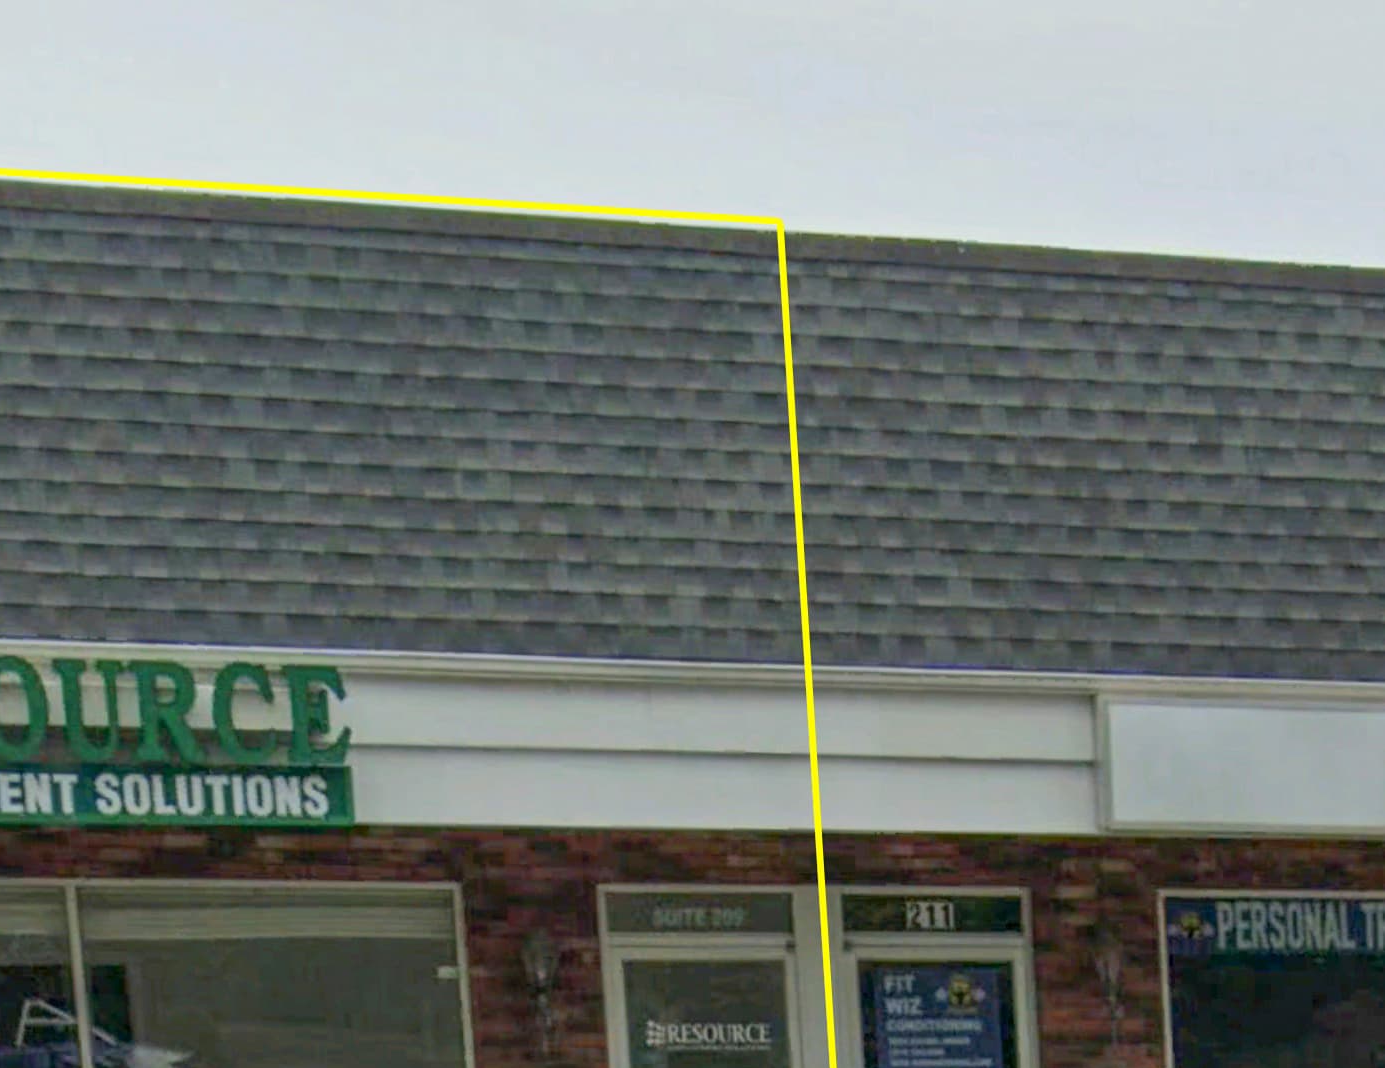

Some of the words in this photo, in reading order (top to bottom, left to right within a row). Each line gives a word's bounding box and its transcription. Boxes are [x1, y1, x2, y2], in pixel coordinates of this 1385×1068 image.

[93, 771, 330, 820] SOLUTIONS
[909, 903, 952, 928] 211
[1215, 899, 1356, 951] PERSONAL
[883, 974, 915, 993] FIT
[883, 996, 923, 1016] WIZ
[667, 1021, 772, 1044] RESOURCE
